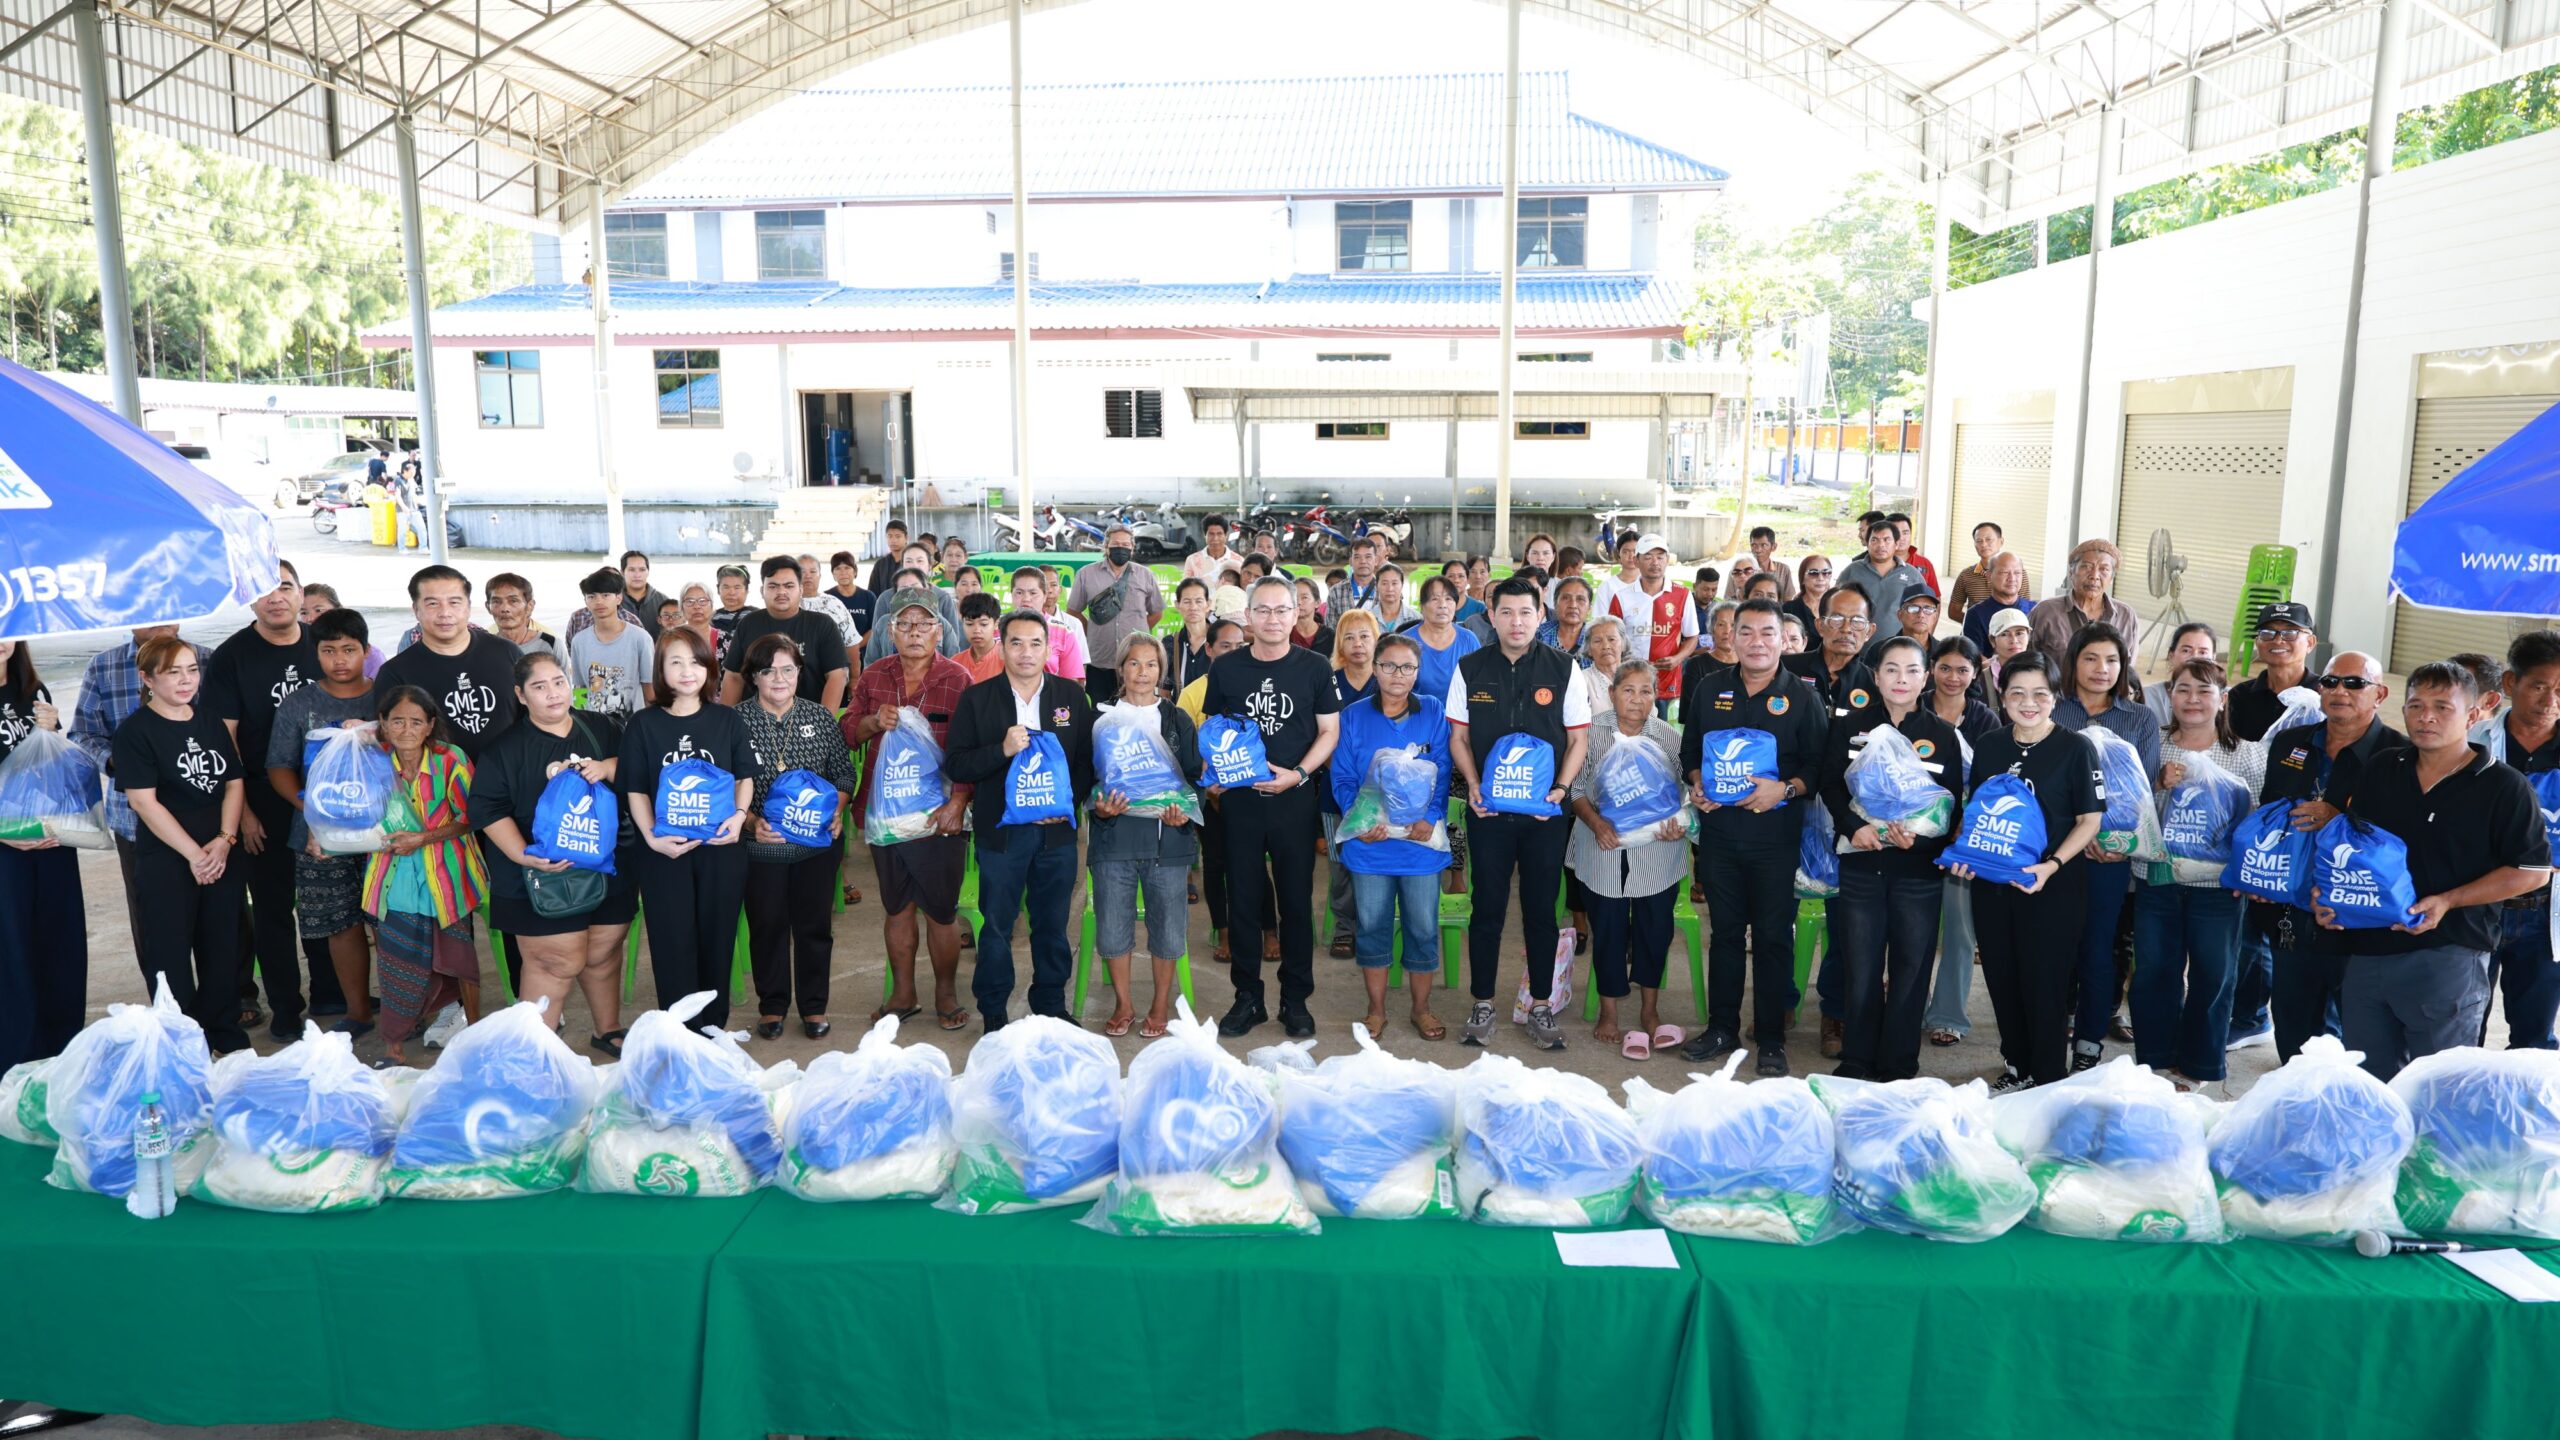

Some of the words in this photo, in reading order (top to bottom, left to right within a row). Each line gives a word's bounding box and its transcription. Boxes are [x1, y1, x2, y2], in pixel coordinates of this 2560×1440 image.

[9, 562, 107, 603] 1357
[445, 689, 480, 717] SME
[480, 686, 496, 712] D
[1245, 692, 1277, 717] SME
[1280, 693, 1294, 719] D
[1113, 740, 1152, 760] SME
[1212, 747, 1251, 768] SME
[177, 752, 210, 779] SME
[209, 750, 227, 776] D
[885, 765, 921, 780] SME
[1121, 758, 1160, 773] Bank
[1215, 760, 1253, 772] Development
[1494, 766, 1534, 780] SME
[1714, 761, 1755, 776] SME
[1017, 771, 1054, 788] SME
[1217, 768, 1257, 784] Bank
[1604, 765, 1642, 792] SME
[884, 784, 921, 798] Bank
[1016, 785, 1055, 794] Development
[1492, 786, 1532, 799] Bank
[1613, 782, 1650, 808] Bank
[1715, 780, 1756, 794] Bank
[668, 792, 710, 808] SME
[1015, 792, 1056, 807] Bank
[667, 813, 707, 826] Bank
[784, 805, 822, 824] SME
[2170, 808, 2207, 824] SME
[561, 813, 600, 834] SME
[781, 818, 818, 837] Bank
[1975, 814, 2022, 839] SME
[558, 826, 600, 841] Development
[1972, 827, 2017, 845] Development
[2164, 828, 2206, 844] Bank
[557, 834, 600, 854] Bank
[1967, 833, 2015, 857] Bank
[2243, 849, 2291, 870] SME
[2242, 863, 2290, 878] Development
[2330, 869, 2377, 885] SME
[2240, 869, 2289, 892] Bank
[2330, 888, 2381, 908] Bank
